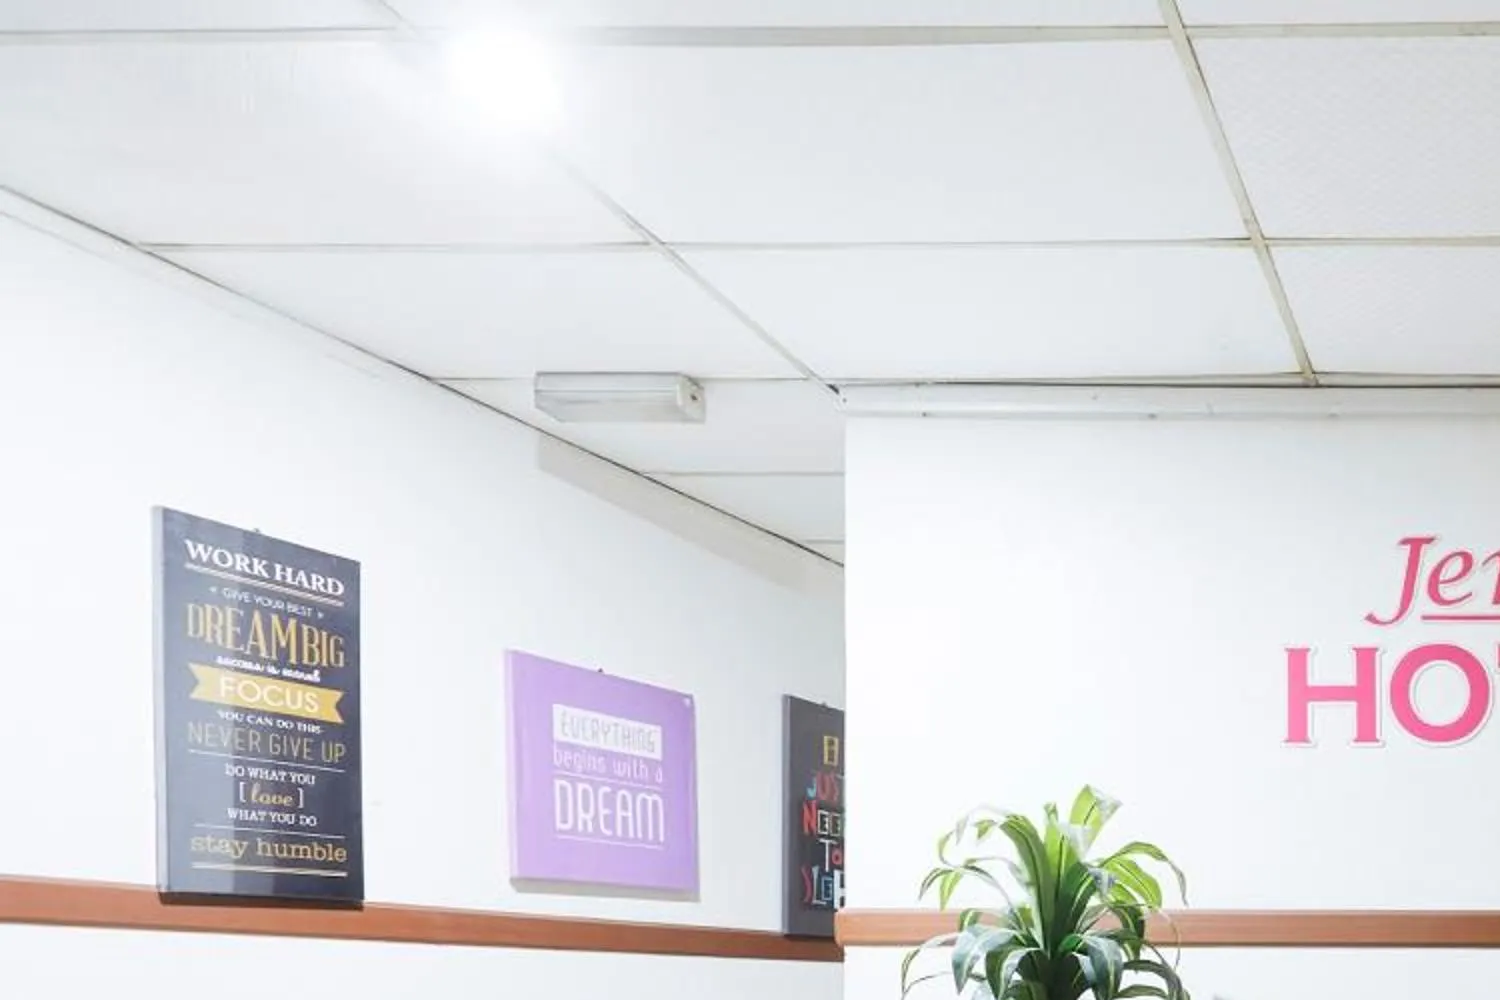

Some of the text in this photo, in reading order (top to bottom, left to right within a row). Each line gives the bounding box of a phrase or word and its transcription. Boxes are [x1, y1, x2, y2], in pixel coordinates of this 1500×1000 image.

[184, 539, 345, 596] WORK HARD
[222, 587, 313, 618] GIVE YOUR BEST
[186, 602, 345, 668] DREAM BIG
[219, 673, 320, 714] FOCUS
[217, 709, 244, 722] YOU
[246, 713, 273, 727] CAN
[275, 718, 294, 731] DO
[560, 709, 656, 754] EVERYTHING
[187, 720, 346, 764] NEVER GIVE UP
[553, 741, 607, 774] begins
[613, 756, 649, 779] with
[225, 763, 316, 787] DO WHAT YOU
[227, 807, 318, 827] WHAT YOU DO
[554, 778, 665, 842] DREAM
[190, 834, 348, 863] stay humble
